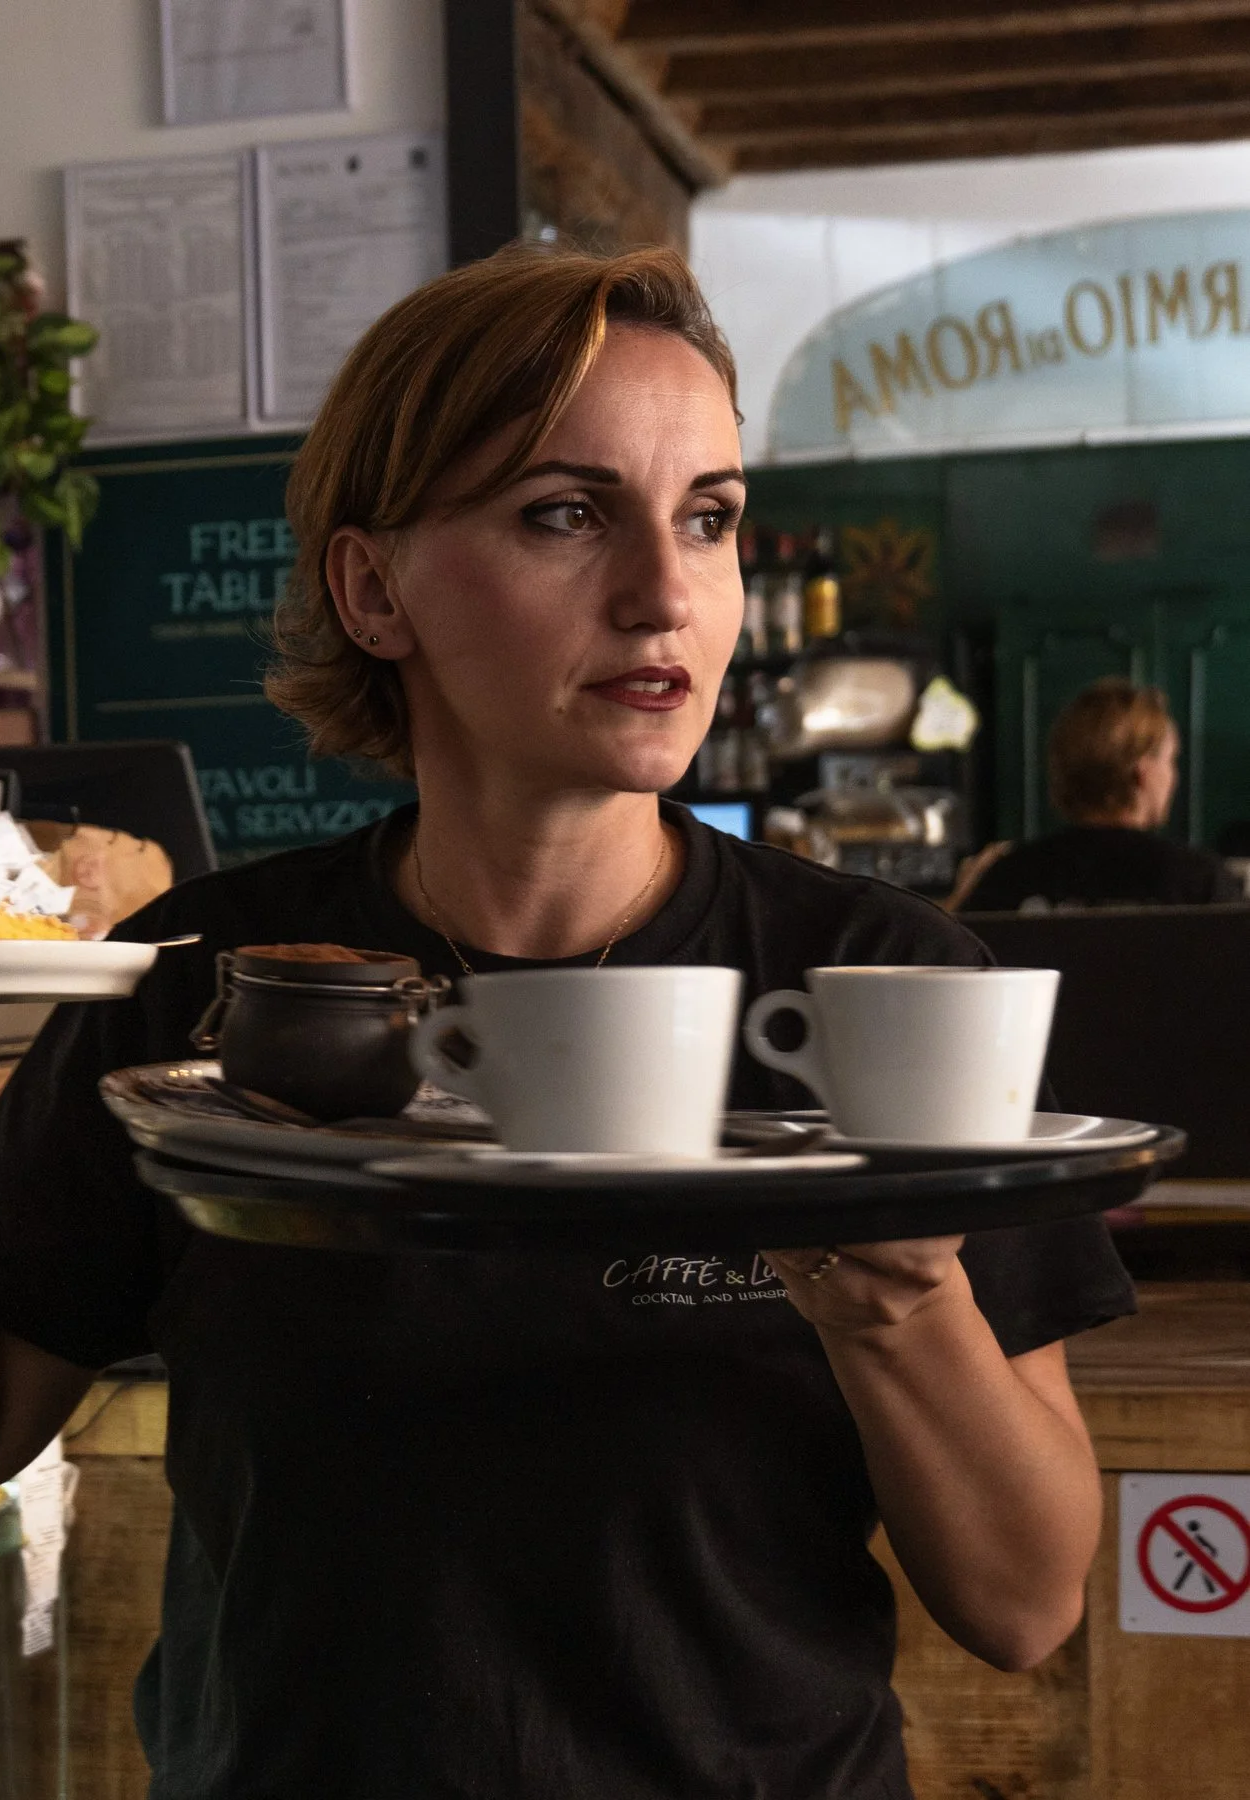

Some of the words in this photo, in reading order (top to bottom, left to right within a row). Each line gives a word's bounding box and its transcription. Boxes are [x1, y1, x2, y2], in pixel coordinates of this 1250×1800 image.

[189, 517, 299, 564] FREE
[725, 1270, 746, 1285] &
[631, 1292, 697, 1306] COCKTAIL
[702, 1293, 733, 1303] AND
